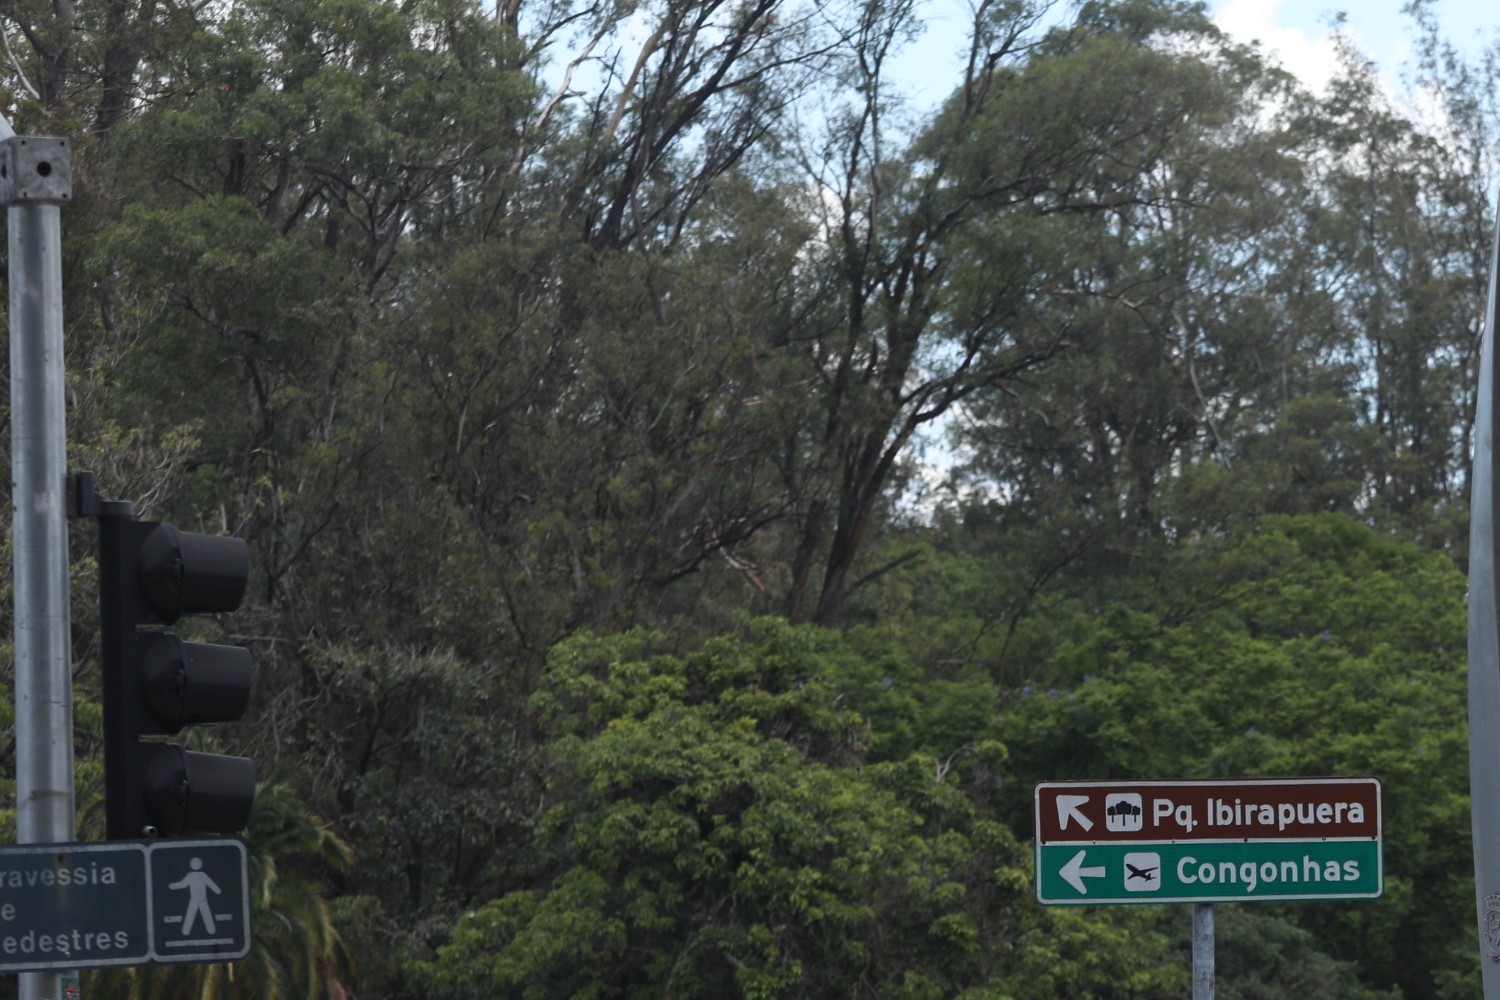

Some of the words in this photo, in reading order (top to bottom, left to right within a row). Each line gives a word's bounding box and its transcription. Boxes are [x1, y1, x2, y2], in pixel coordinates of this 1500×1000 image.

[1153, 798, 1198, 832] Pq.
[1207, 798, 1364, 831] Ibirapuera
[0, 862, 116, 887] ravessia
[1176, 854, 1360, 892] Congonhas
[3, 929, 129, 954] edestres
